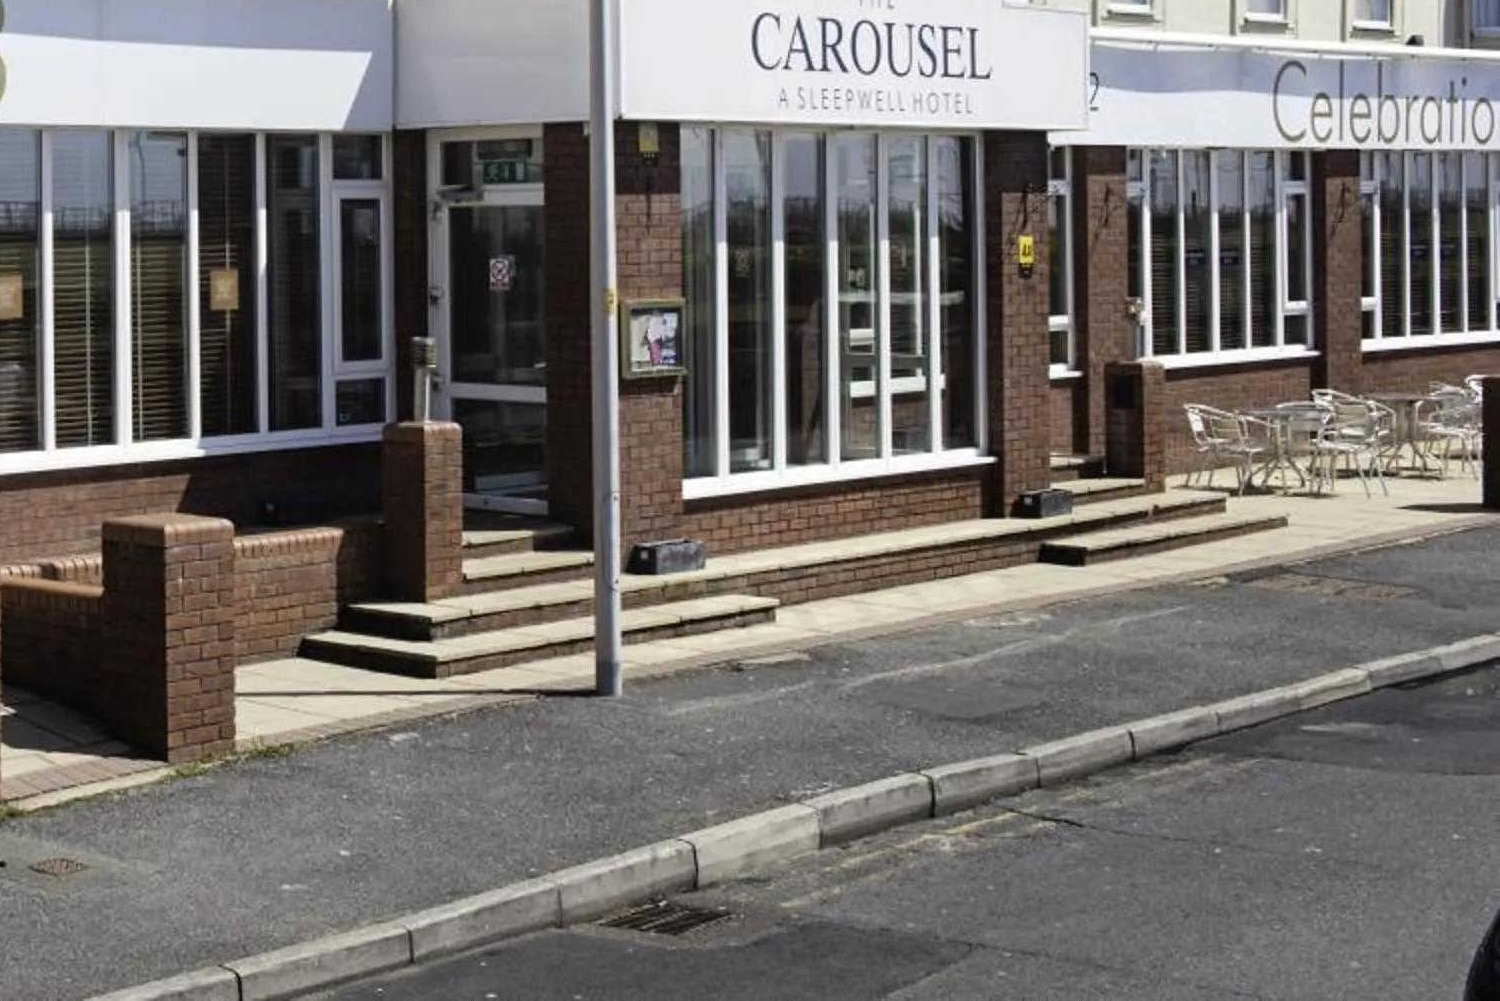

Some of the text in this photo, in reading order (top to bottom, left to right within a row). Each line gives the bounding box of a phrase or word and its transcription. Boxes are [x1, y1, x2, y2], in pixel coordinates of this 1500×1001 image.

[751, 11, 993, 80] CAROUSEL
[778, 86, 974, 115] A SLEEPWELL HOTEL
[1272, 59, 1495, 145] Celebratio
